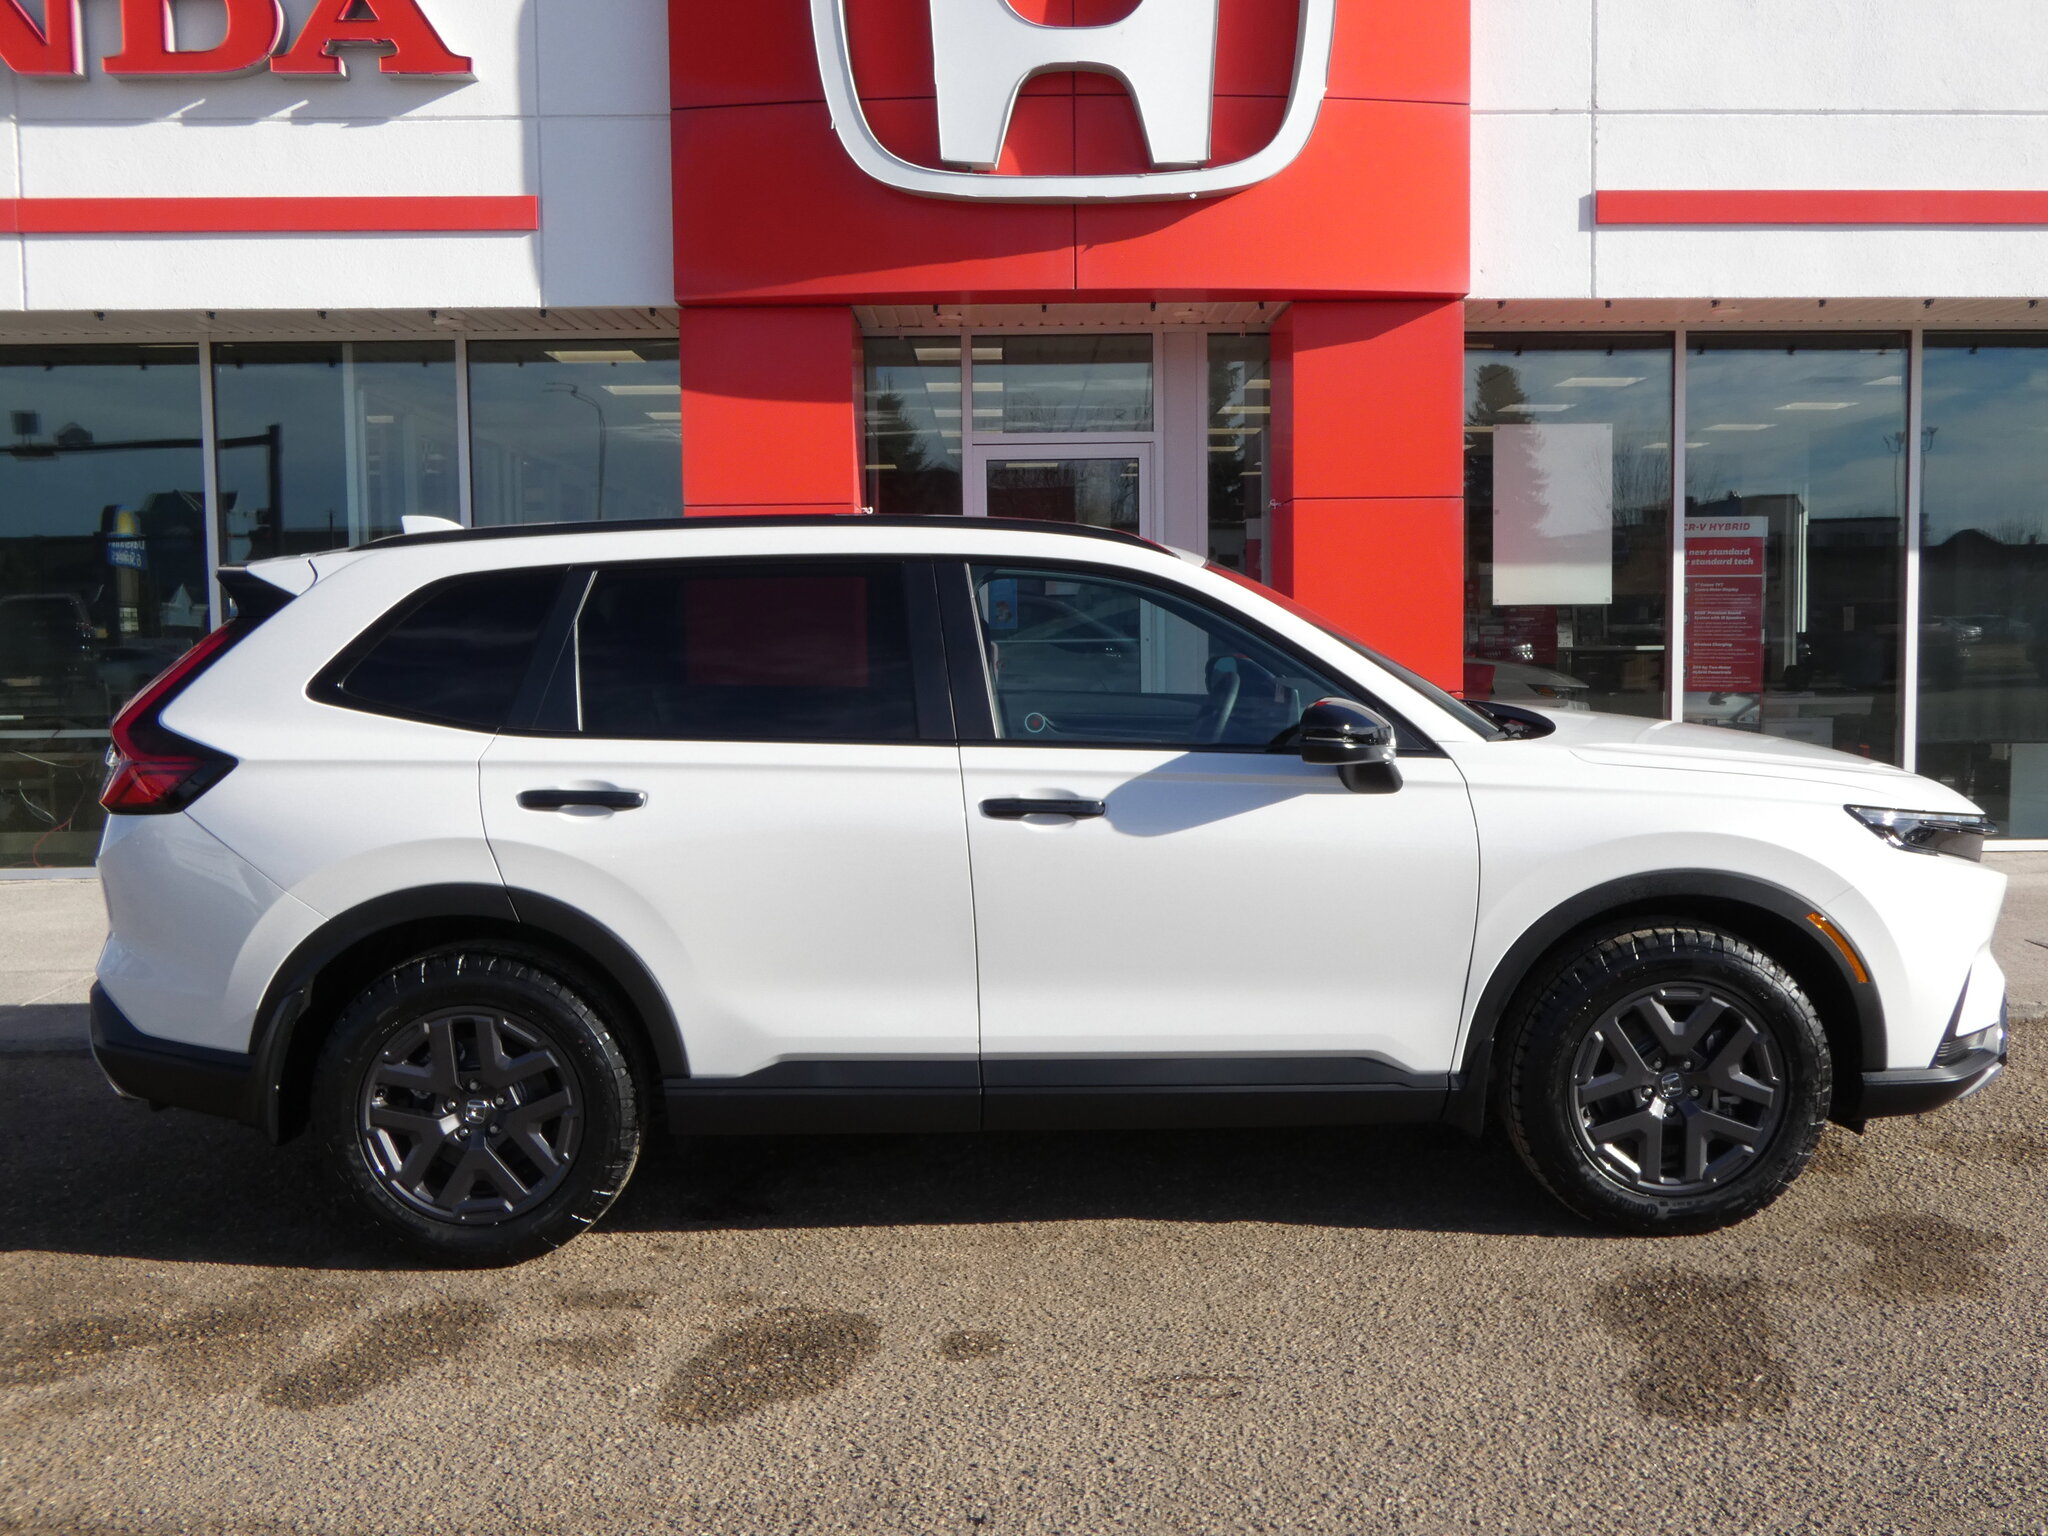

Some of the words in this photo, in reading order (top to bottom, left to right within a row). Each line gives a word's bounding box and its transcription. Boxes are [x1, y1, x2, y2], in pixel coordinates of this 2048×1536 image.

[1708, 522, 1751, 531] HYBRID
[1708, 547, 1751, 556] standard
[1691, 557, 1733, 566] standard
[1734, 557, 1754, 566] tech
